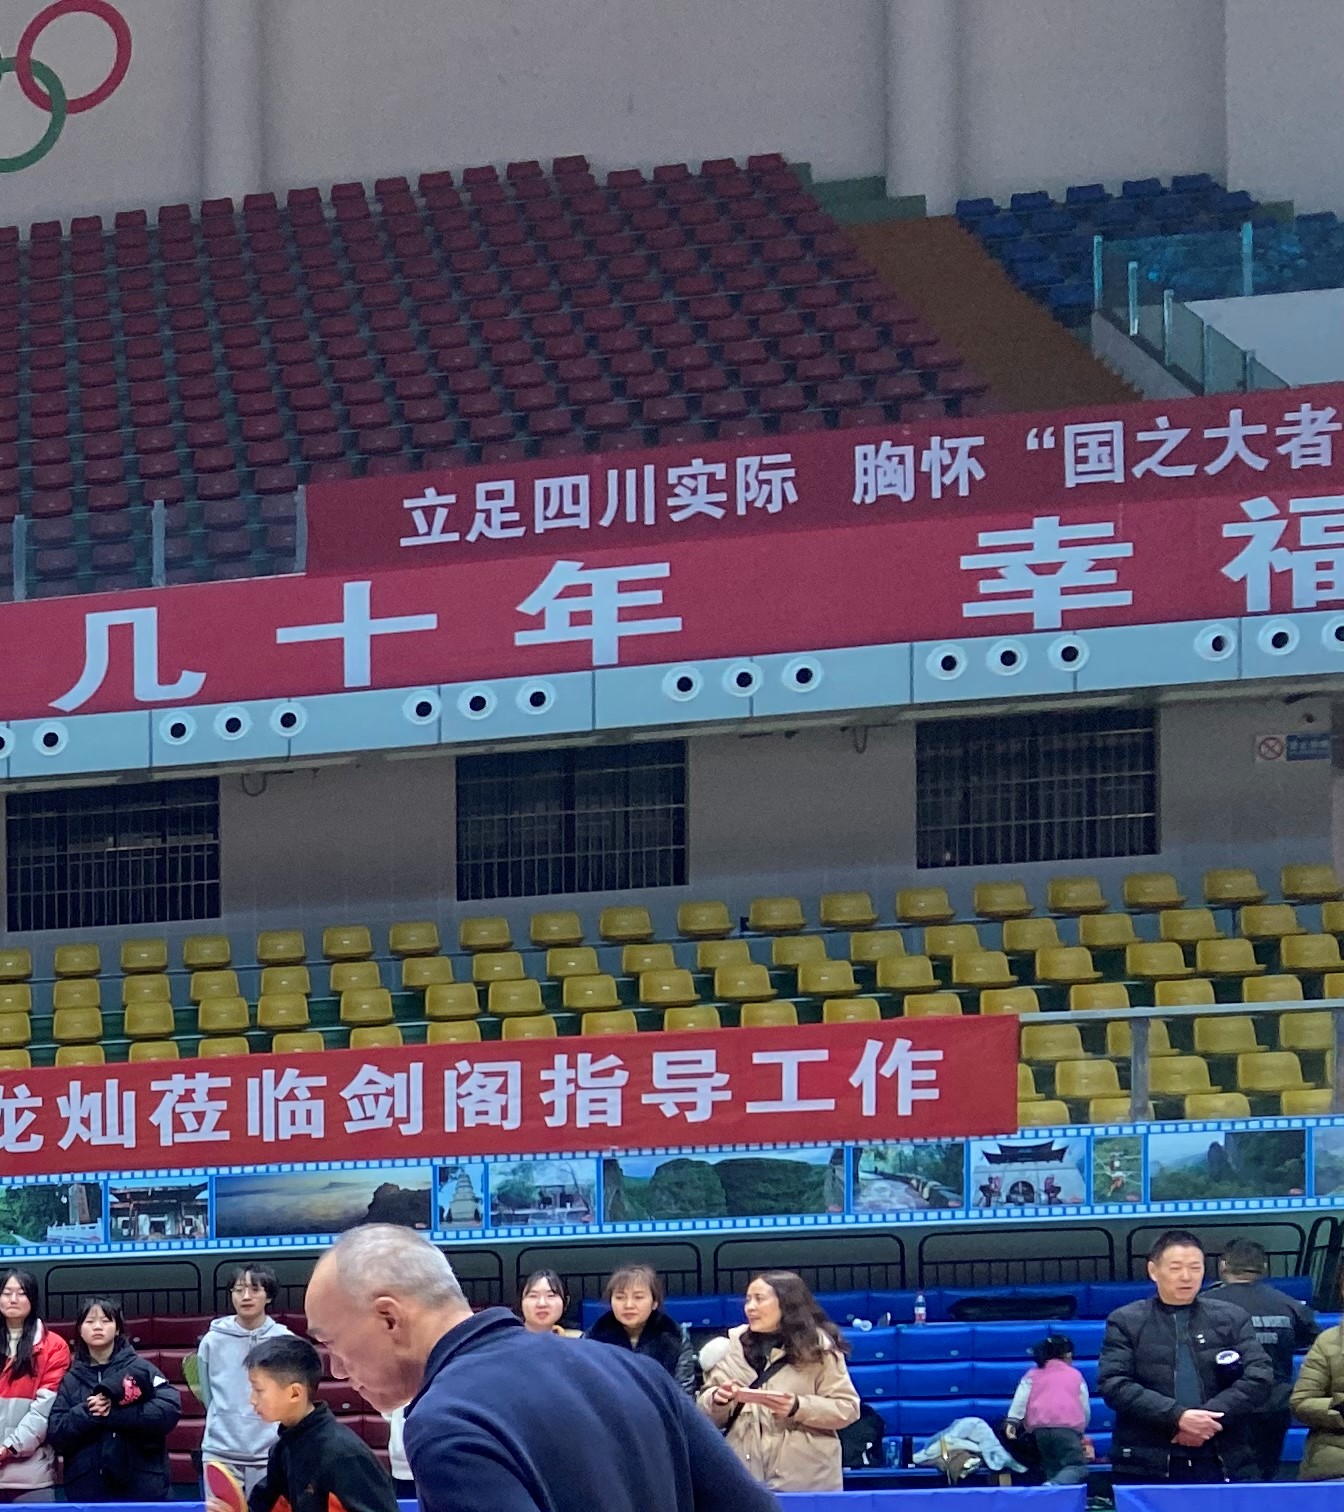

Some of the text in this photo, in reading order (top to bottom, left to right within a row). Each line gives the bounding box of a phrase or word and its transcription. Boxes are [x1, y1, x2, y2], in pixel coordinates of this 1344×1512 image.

[399, 453, 799, 547] 立足四川实际
[852, 435, 987, 506] 胸怀
